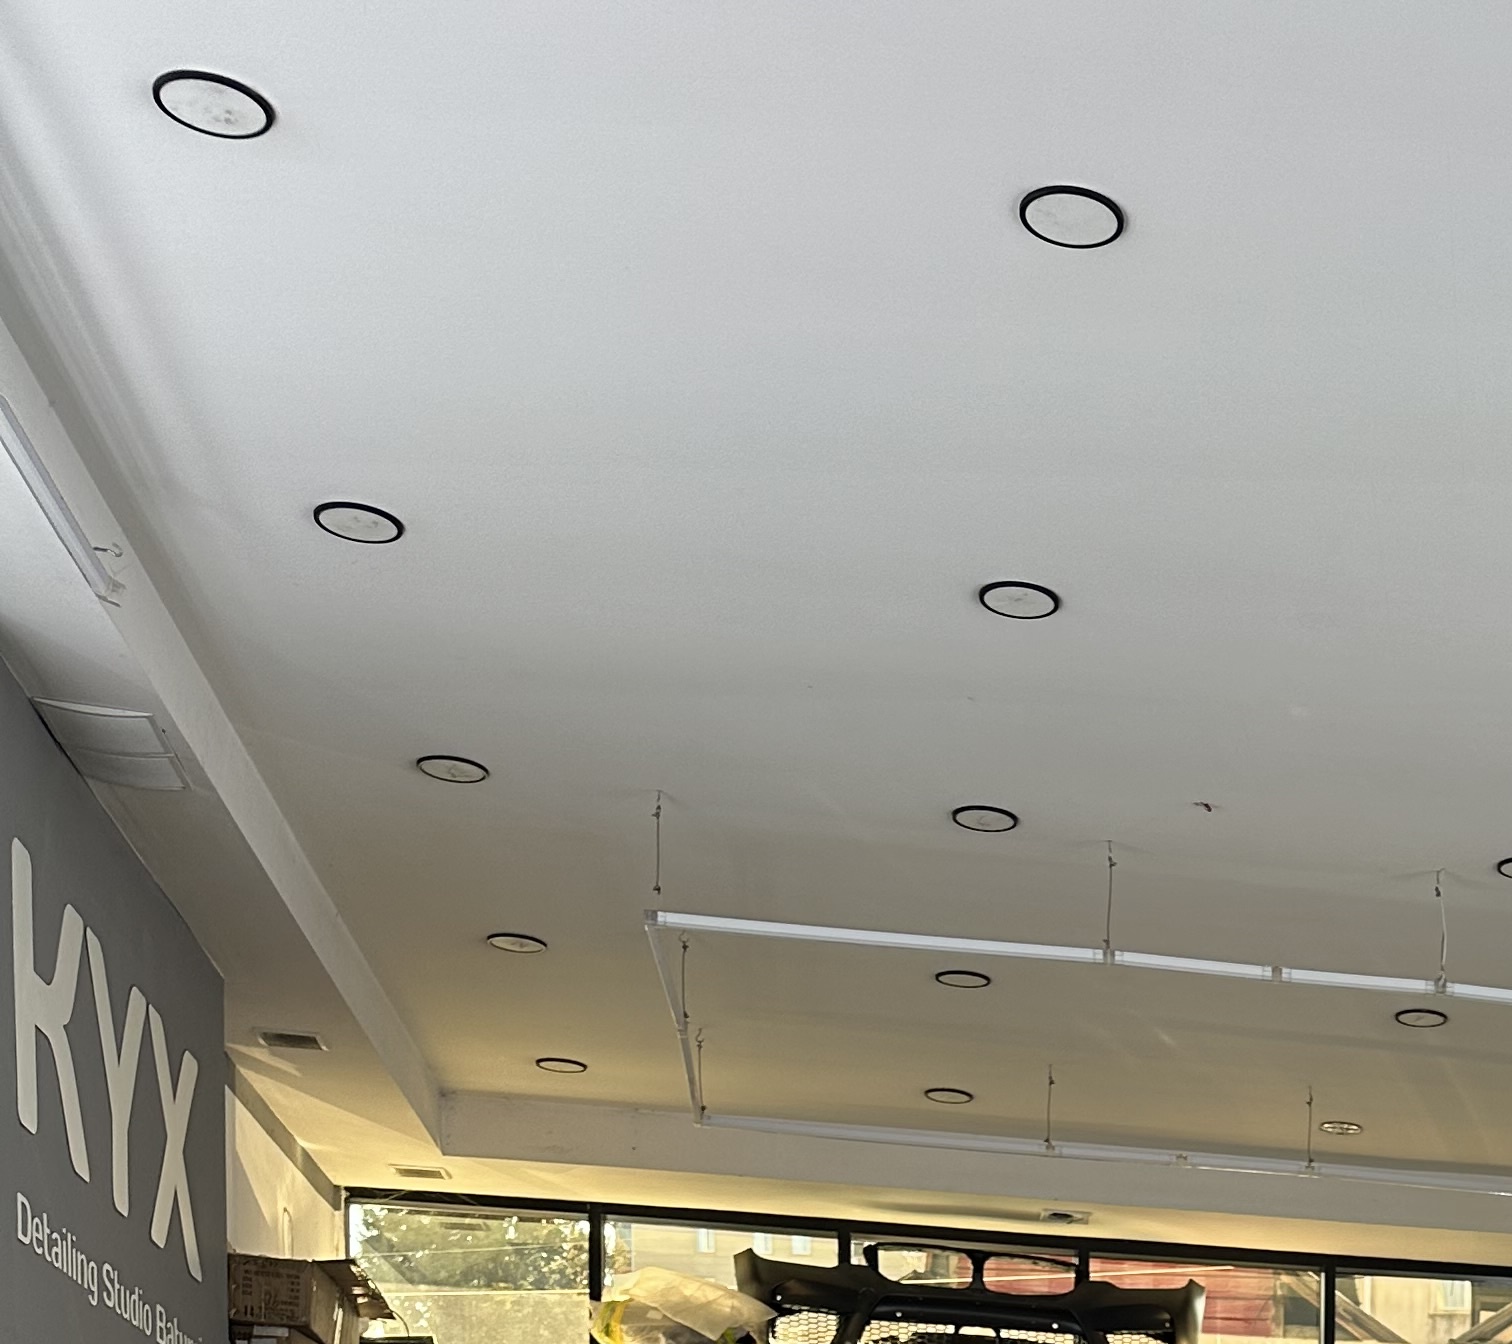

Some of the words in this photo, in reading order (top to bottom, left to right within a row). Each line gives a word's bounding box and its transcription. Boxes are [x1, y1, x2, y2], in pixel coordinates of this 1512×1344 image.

[11, 837, 202, 1282] KYX
[16, 1191, 99, 1306] Detailing
[102, 1262, 152, 1336] Studio
